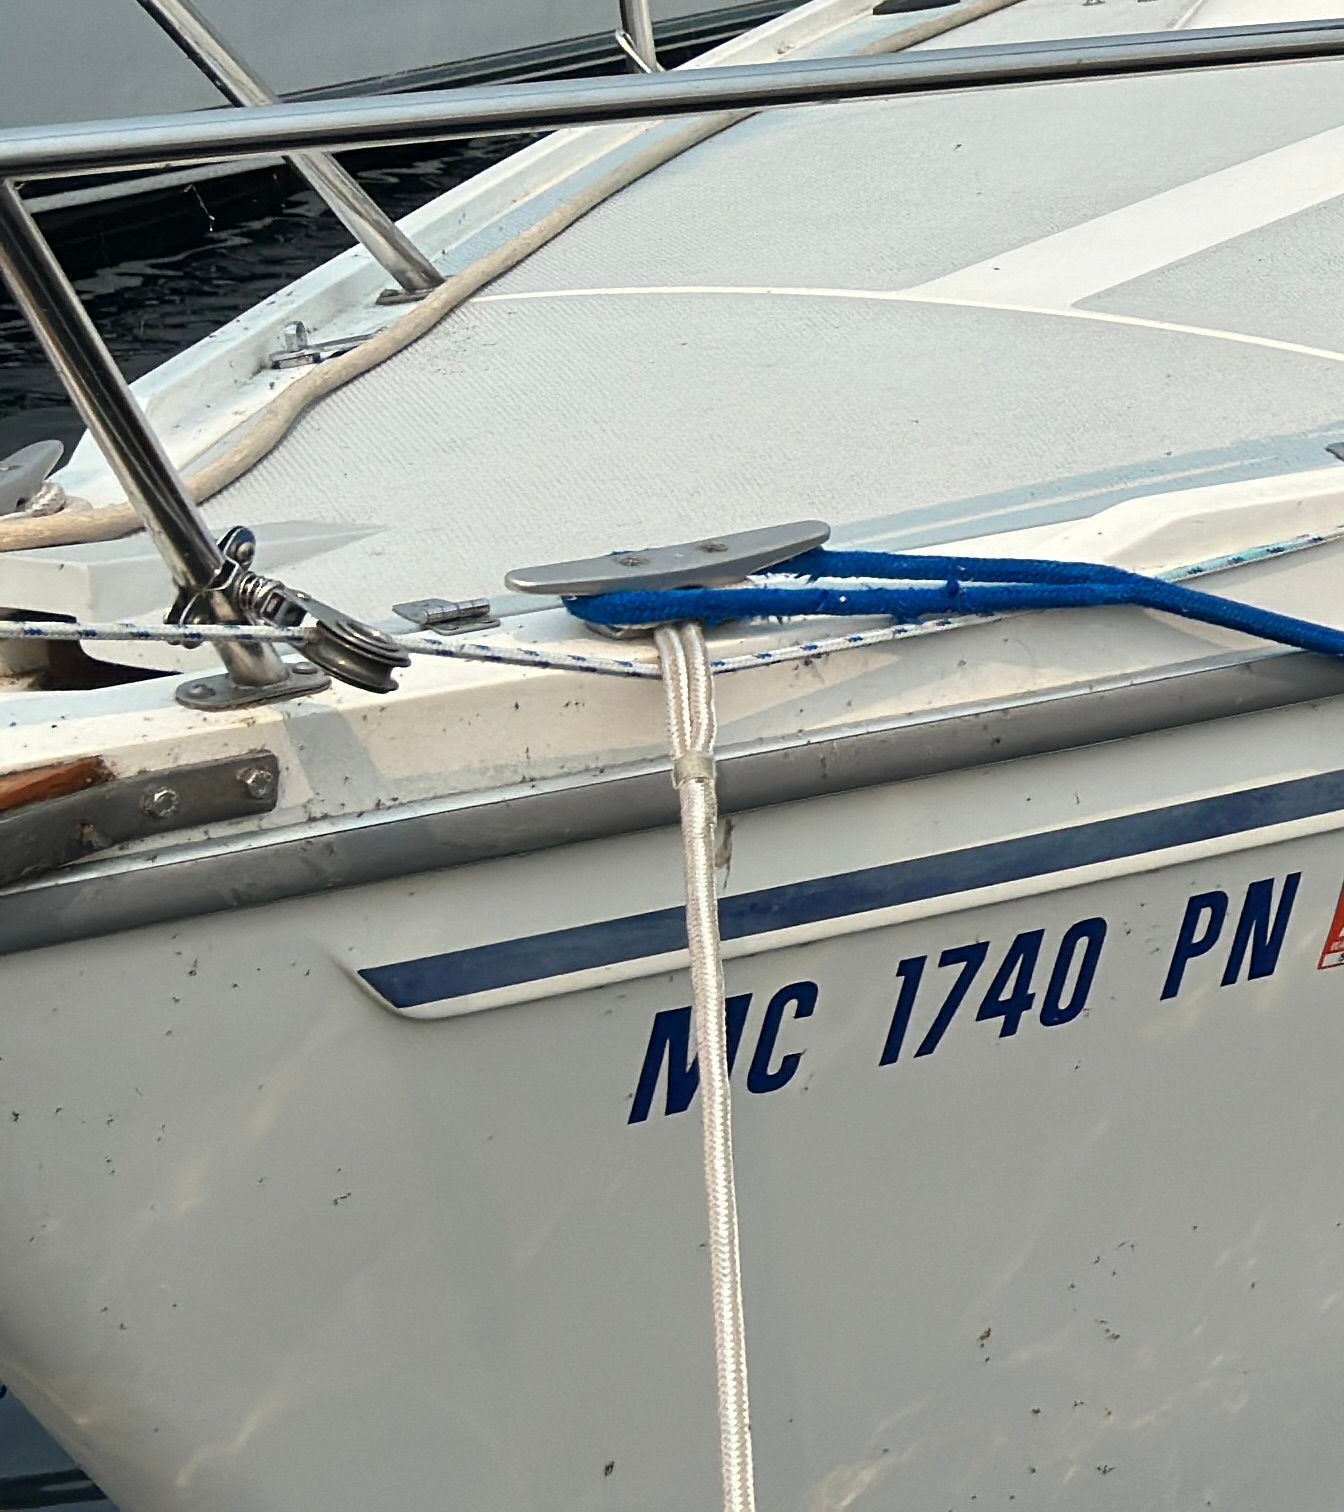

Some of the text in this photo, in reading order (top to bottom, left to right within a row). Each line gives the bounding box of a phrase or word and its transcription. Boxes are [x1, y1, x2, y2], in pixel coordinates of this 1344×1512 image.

[627, 871, 1302, 1125] MC 1740 PN
